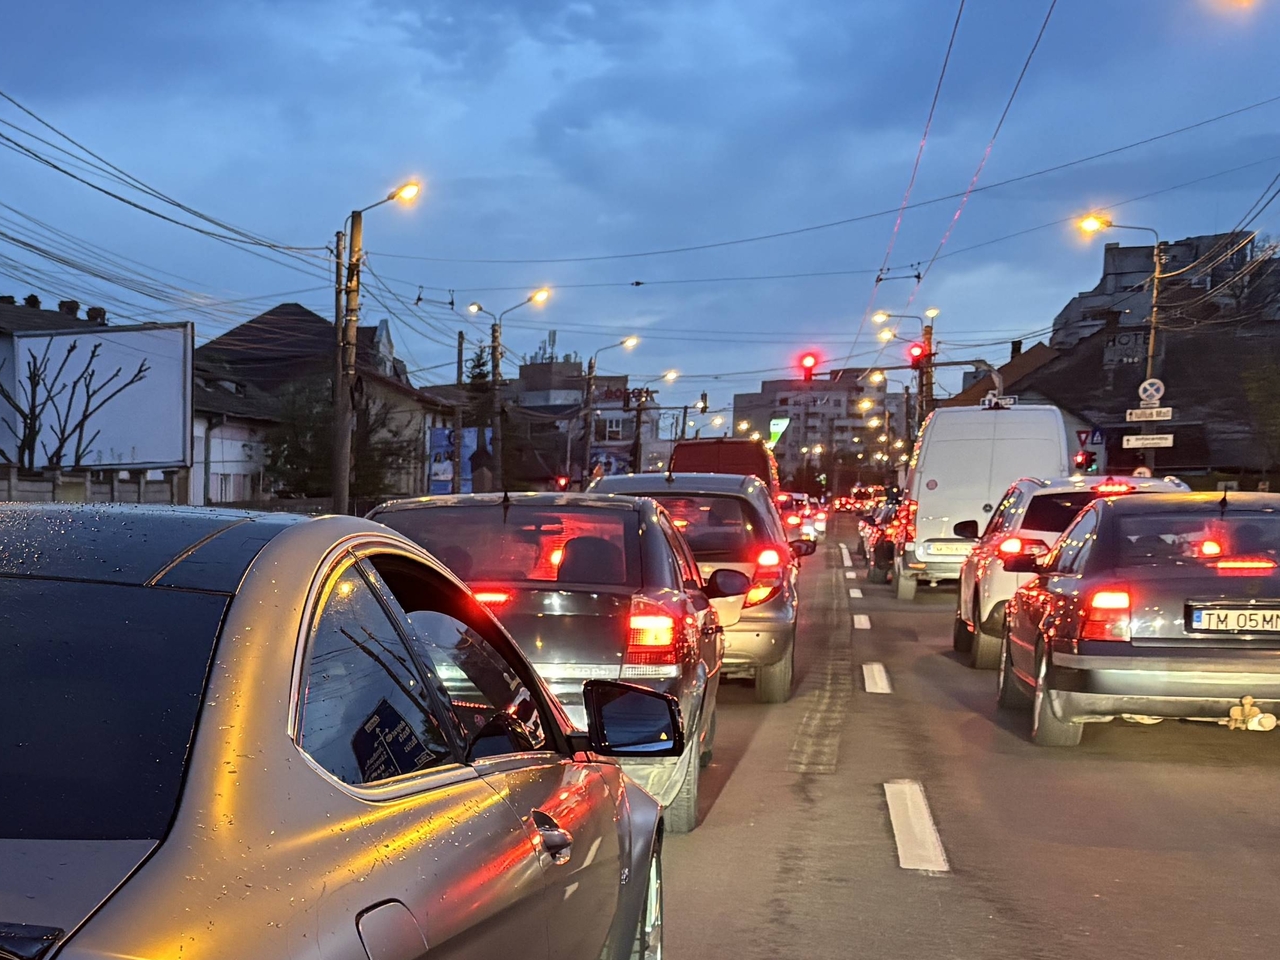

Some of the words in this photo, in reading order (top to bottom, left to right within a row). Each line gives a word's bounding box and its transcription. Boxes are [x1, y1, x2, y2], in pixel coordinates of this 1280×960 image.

[1106, 332, 1151, 347] HOTE
[1205, 613, 1228, 629] TM
[1236, 613, 1259, 629] 05
